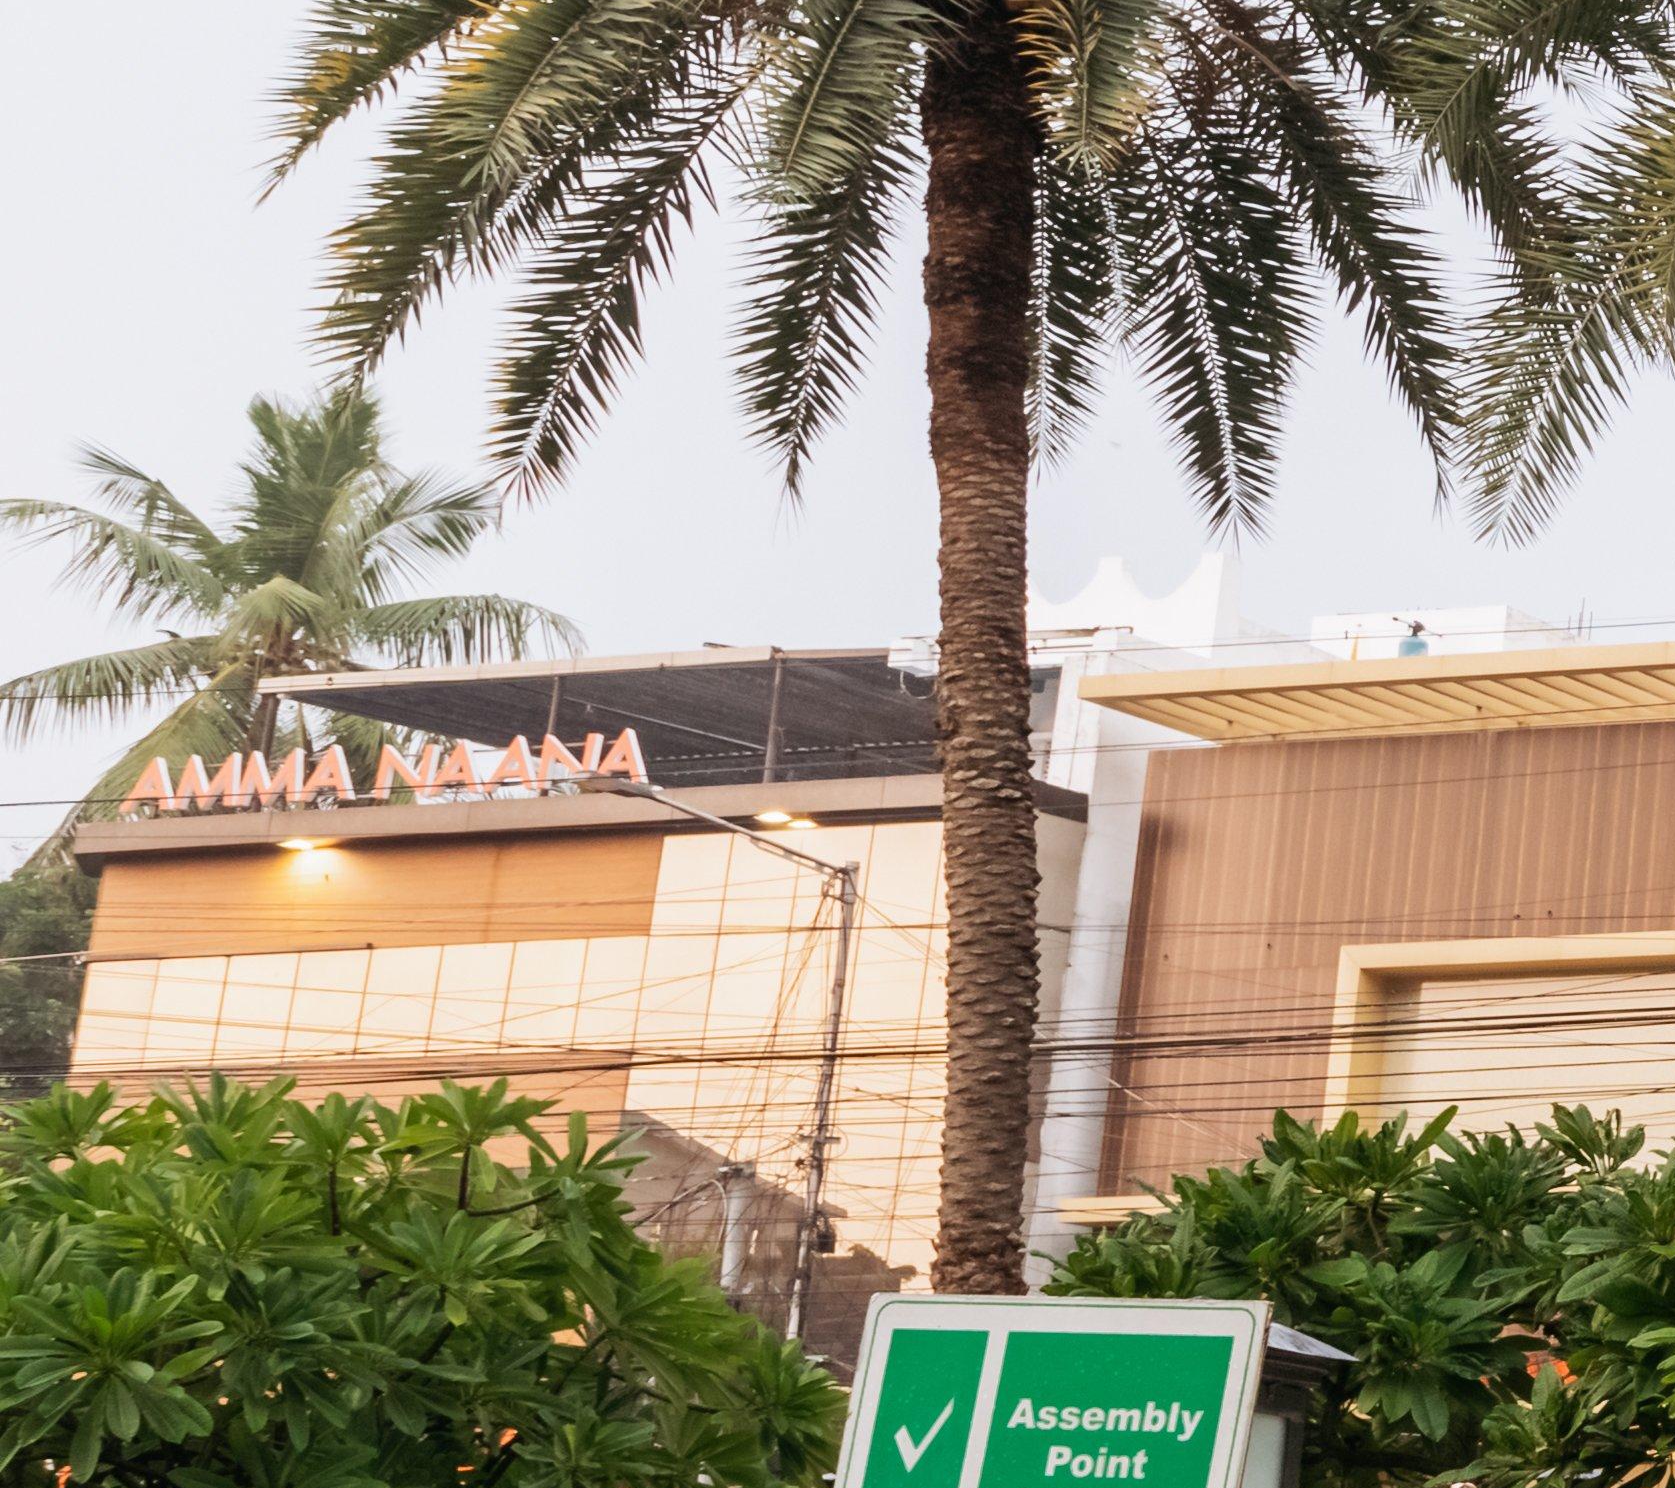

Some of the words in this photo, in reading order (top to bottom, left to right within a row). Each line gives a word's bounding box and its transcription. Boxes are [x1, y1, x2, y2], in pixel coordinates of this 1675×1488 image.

[119, 743, 355, 814] AMMA
[374, 727, 649, 800] NAANA
[1007, 1398, 1203, 1442] Assembly
[1045, 1446, 1148, 1480] Point
